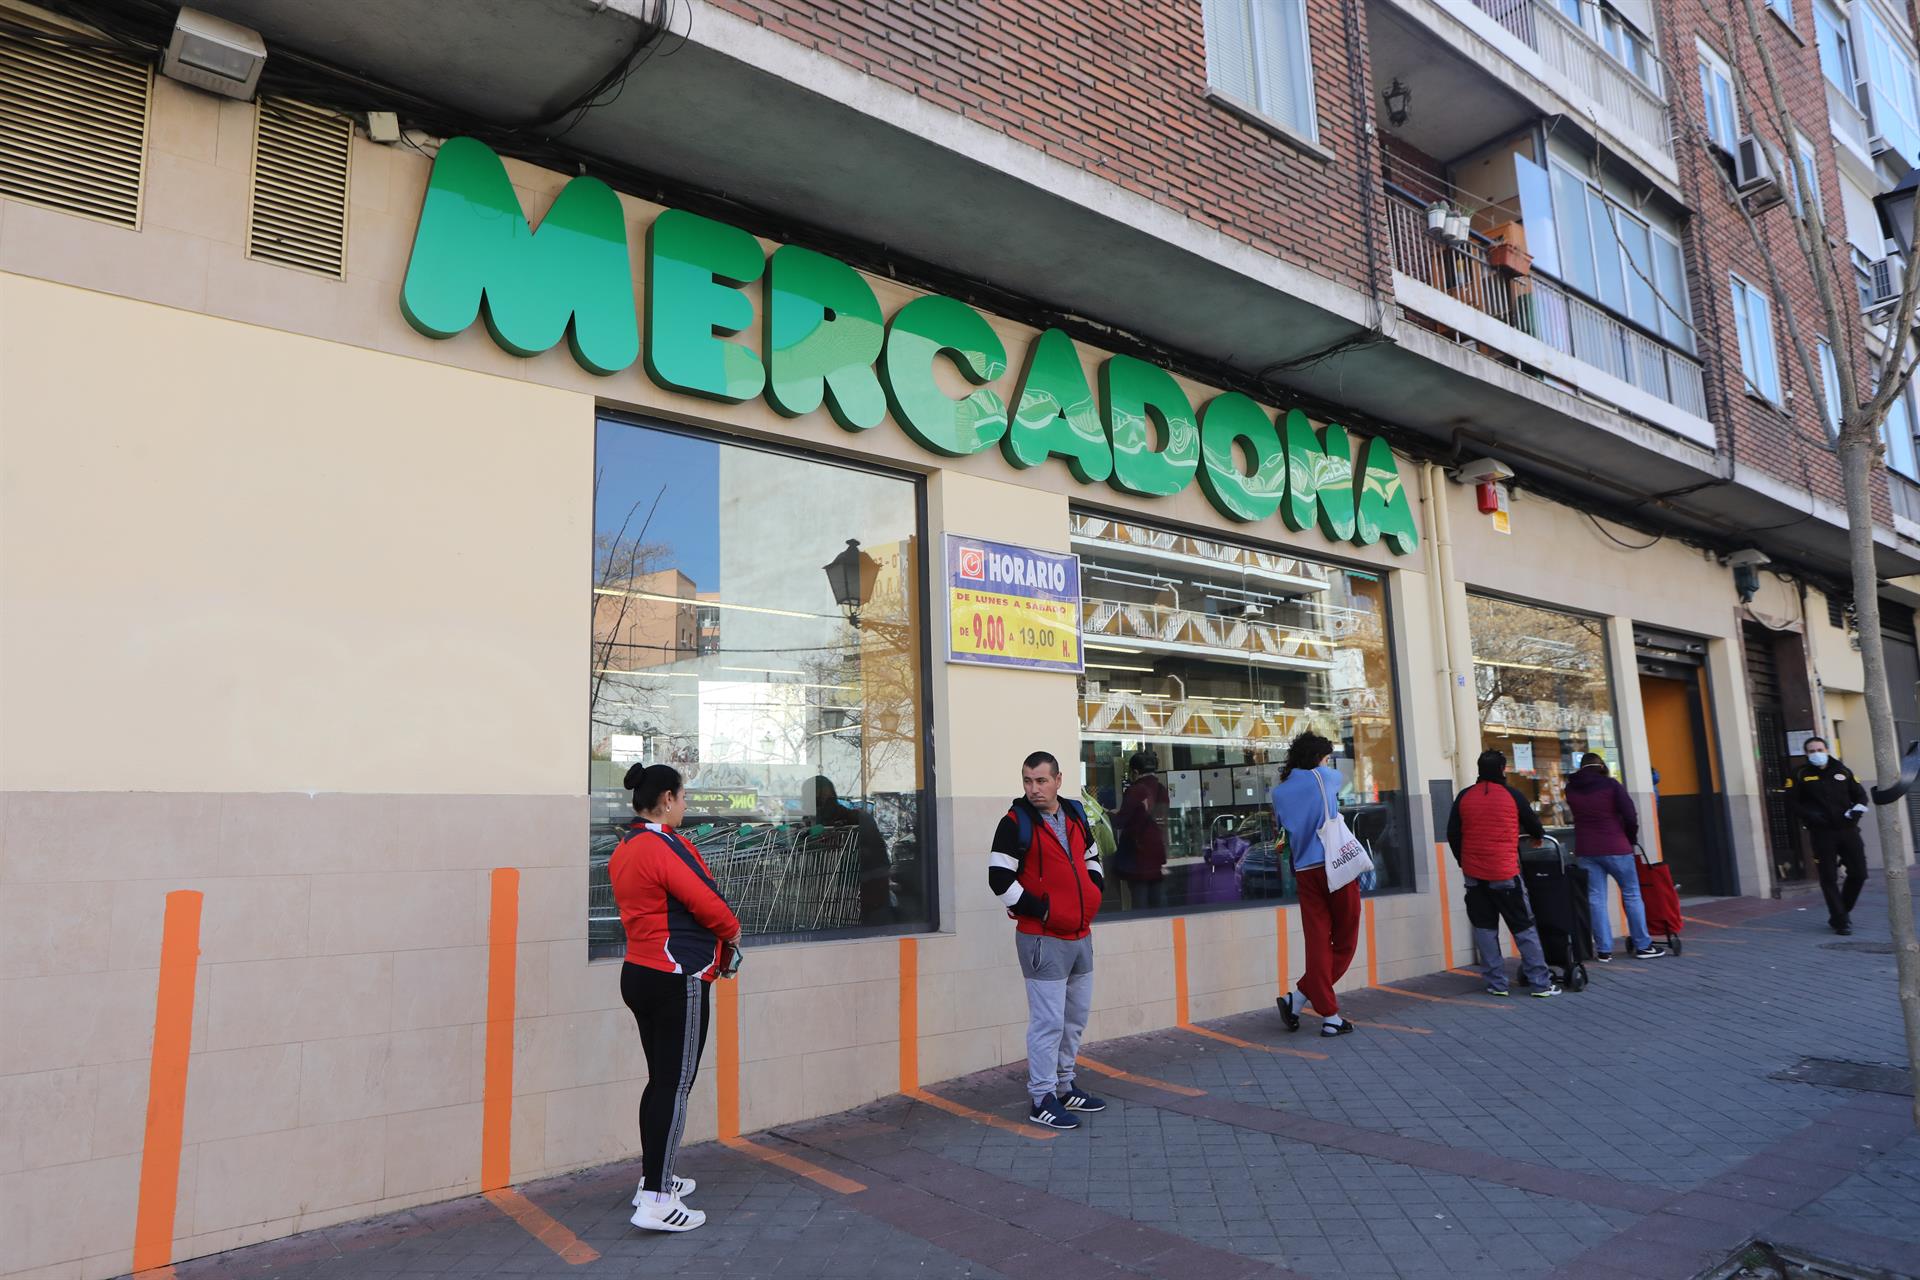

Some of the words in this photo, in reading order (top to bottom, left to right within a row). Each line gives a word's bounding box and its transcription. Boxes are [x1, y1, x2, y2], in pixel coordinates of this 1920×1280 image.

[402, 136, 1419, 555] MERCADONA
[989, 552, 1066, 592] HORARIO
[957, 592, 970, 601] DE
[976, 595, 1008, 606] LUNES
[960, 626, 969, 637] DE
[973, 613, 1004, 651] 9.00
[1009, 633, 1014, 641] A
